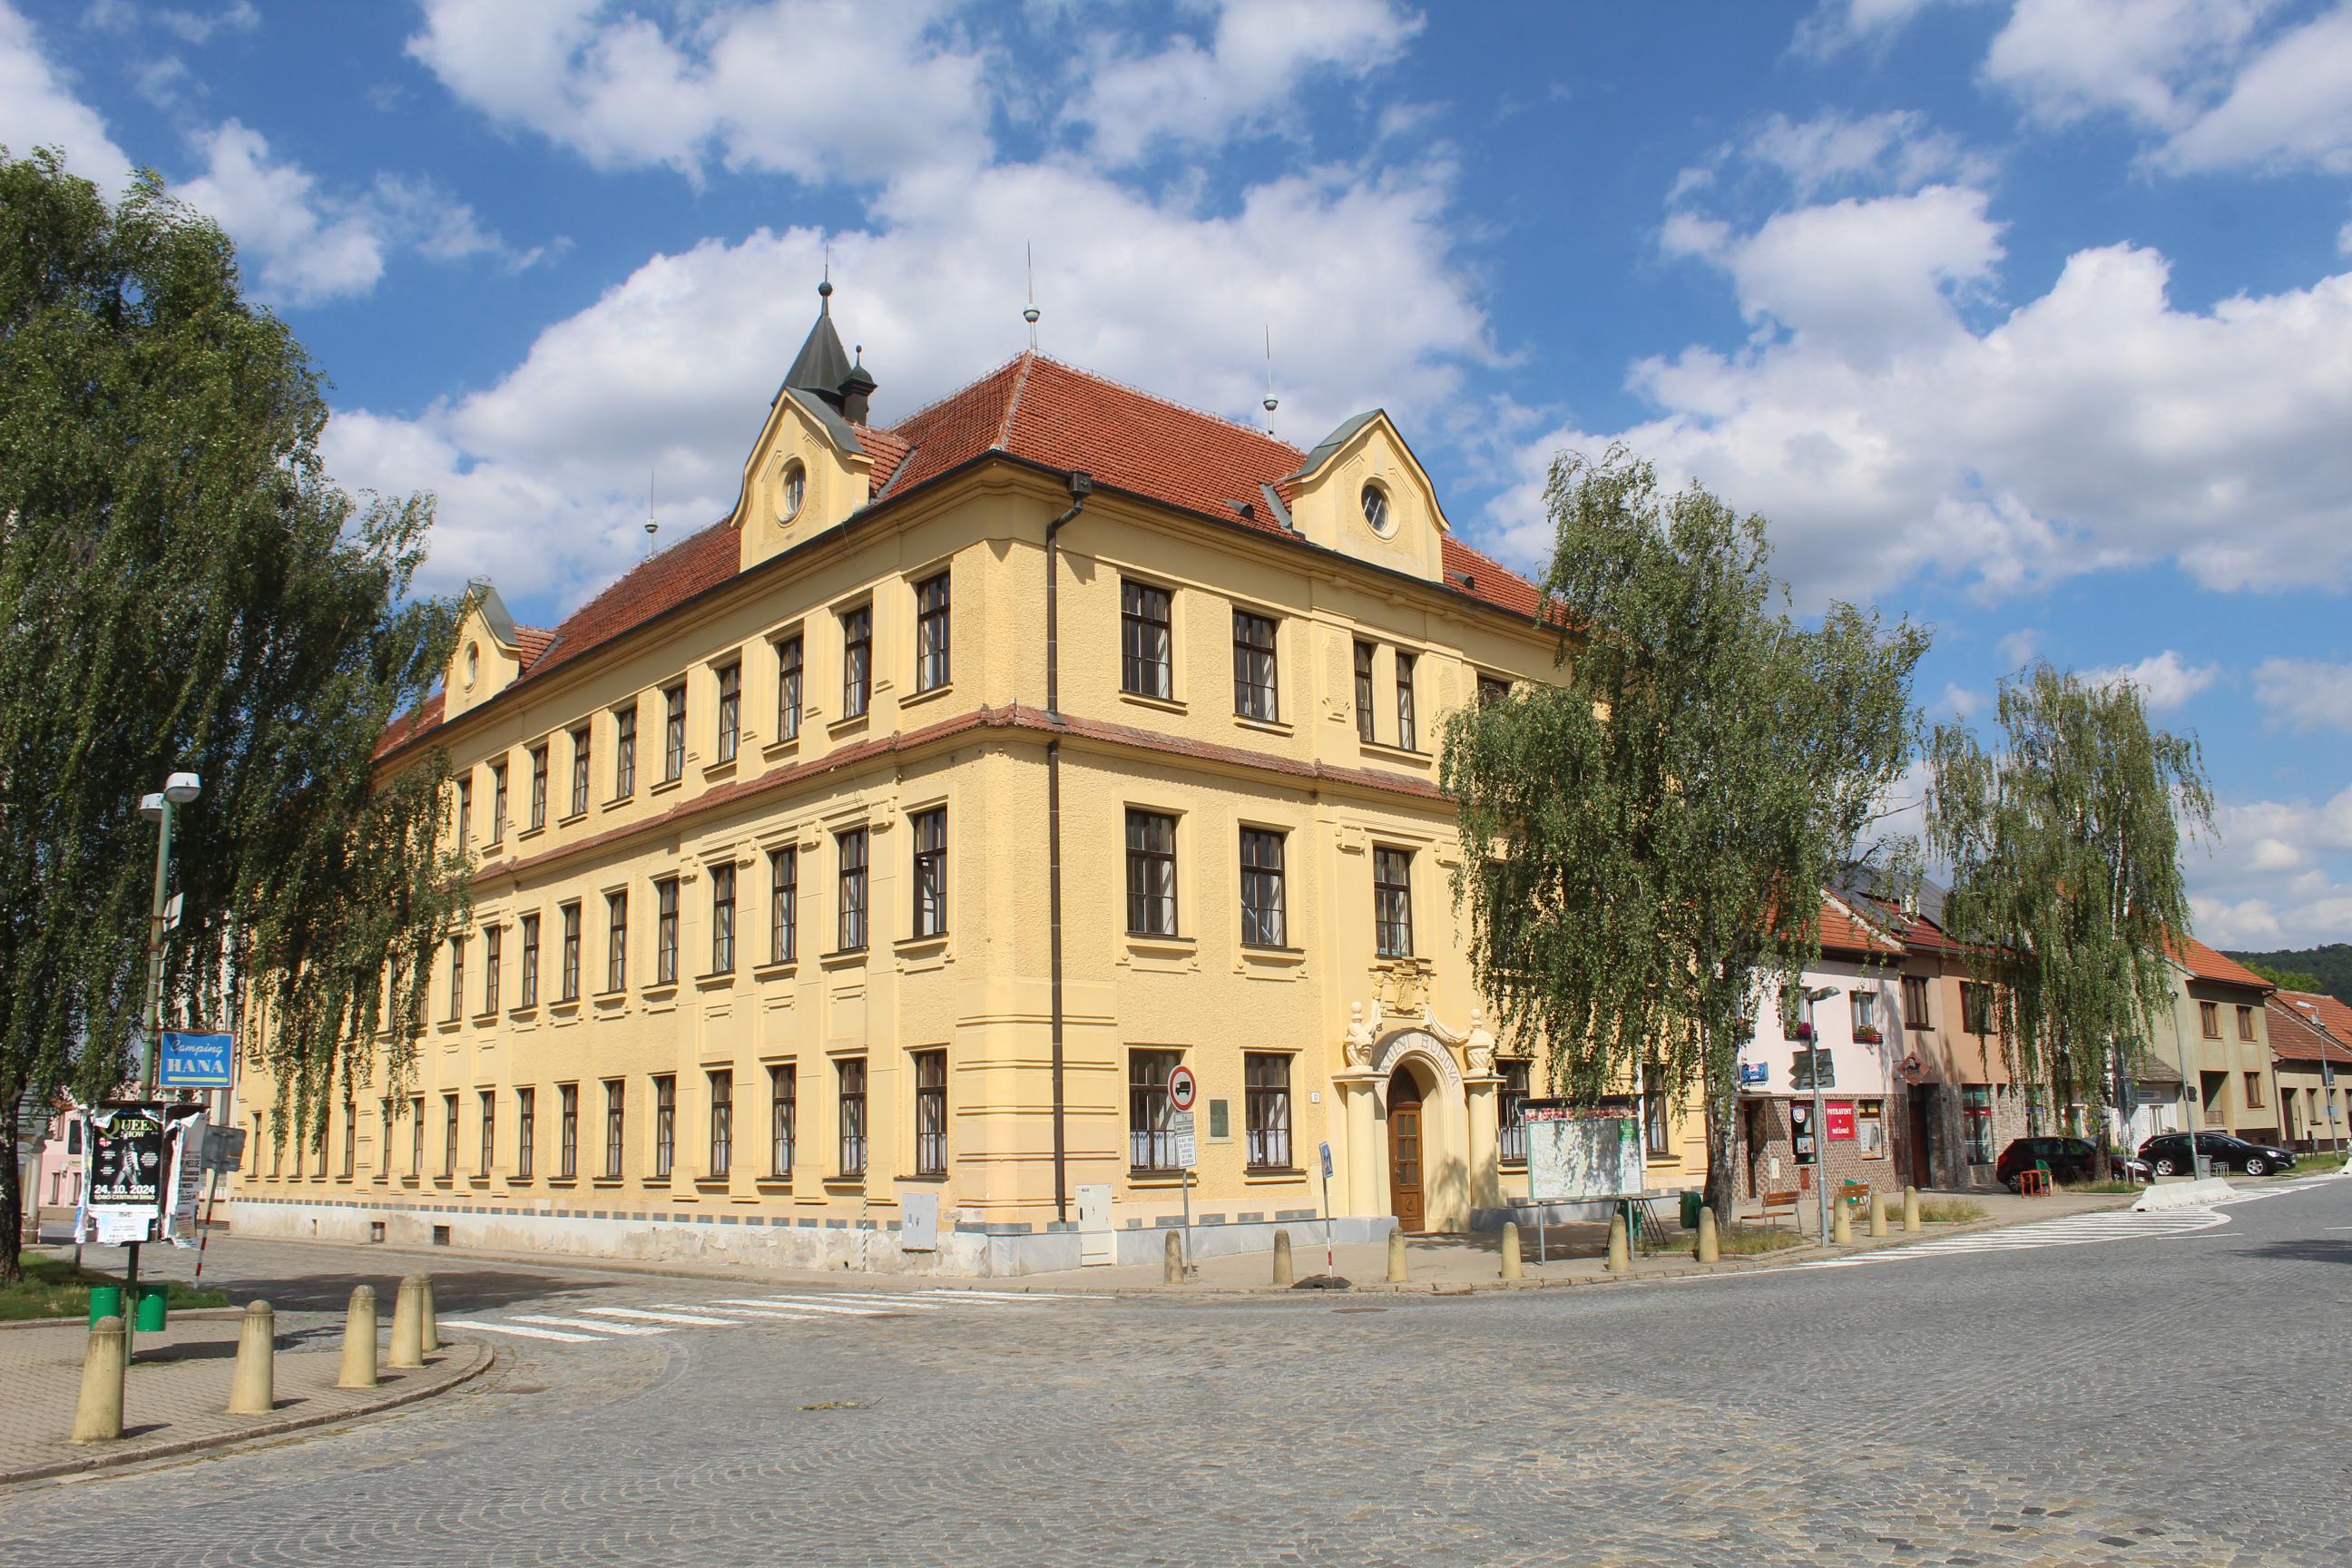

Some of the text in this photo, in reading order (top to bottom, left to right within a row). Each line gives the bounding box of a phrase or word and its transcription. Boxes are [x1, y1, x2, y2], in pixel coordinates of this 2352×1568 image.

[170, 1039, 224, 1057] Camping
[167, 1058, 225, 1073] HANA
[1421, 1034, 1459, 1087] BUDOVA
[93, 1184, 155, 1194] 24. 10. 2024
